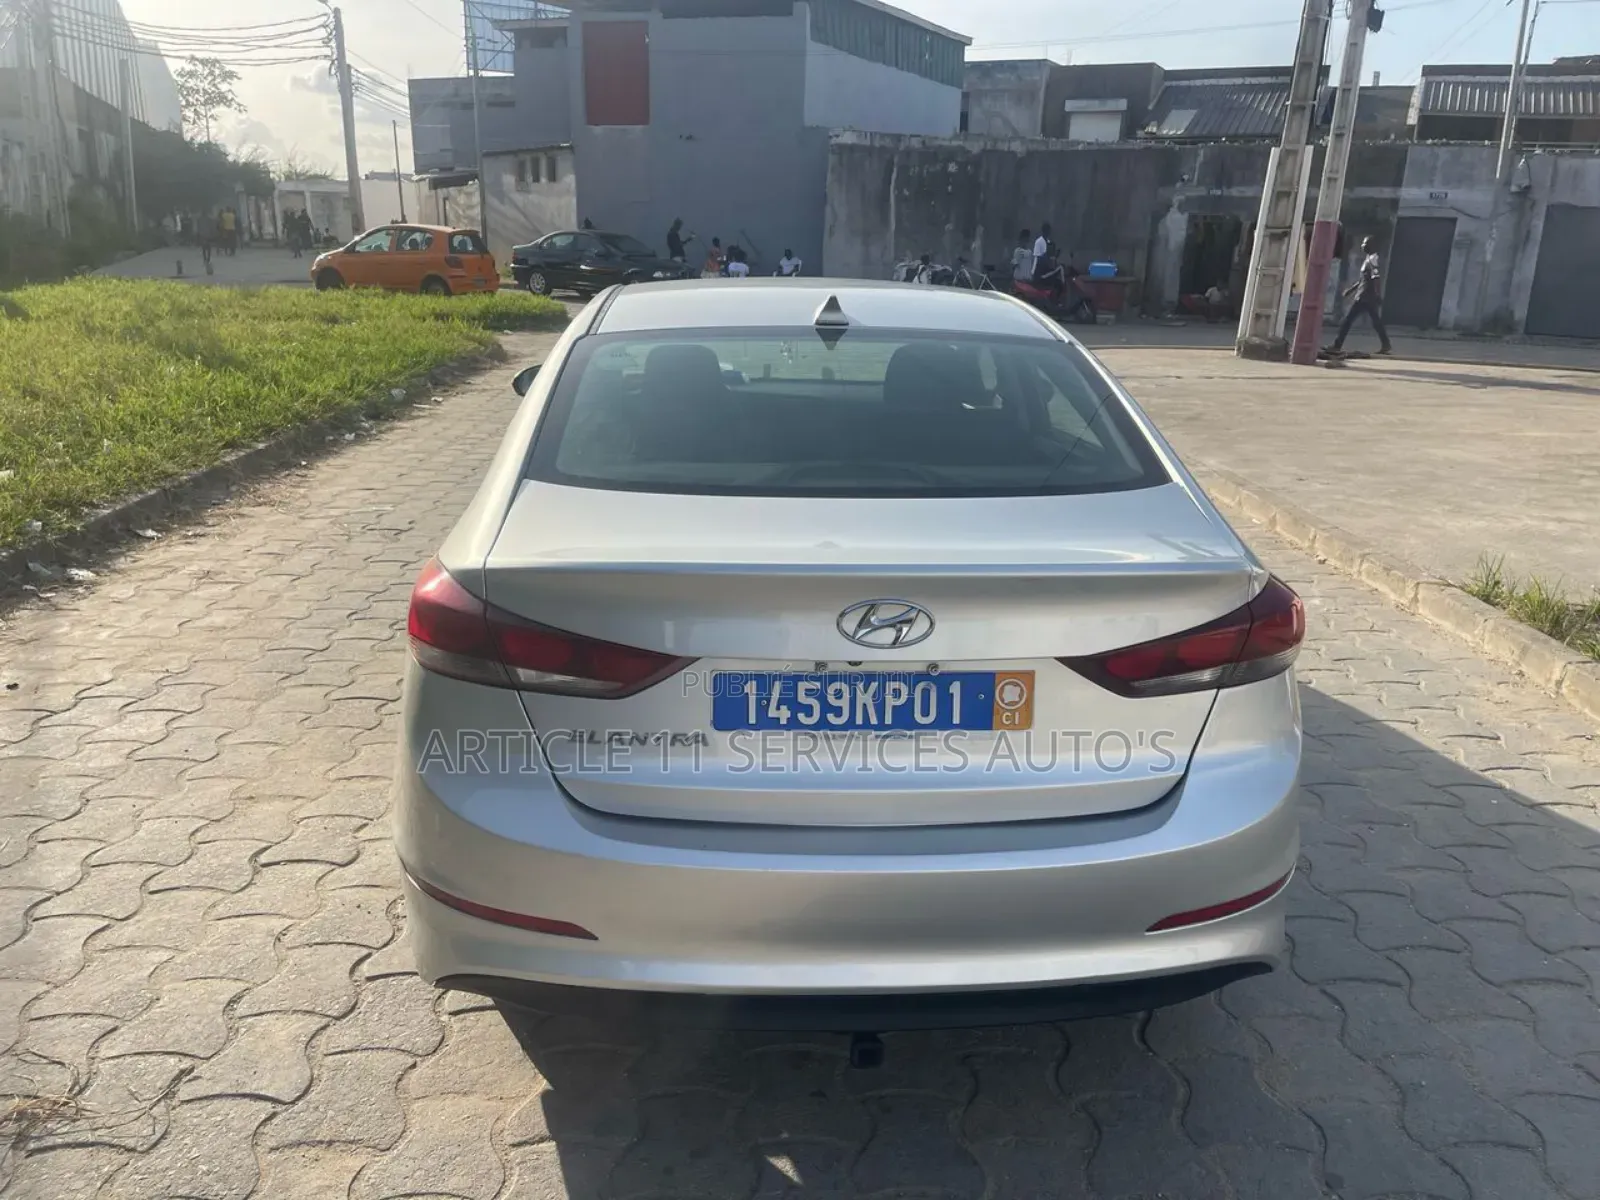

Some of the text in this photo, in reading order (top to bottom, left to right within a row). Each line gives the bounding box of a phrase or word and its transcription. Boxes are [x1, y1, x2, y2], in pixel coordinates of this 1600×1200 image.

[744, 681, 960, 724] 1459KP01
[1001, 711, 1020, 725] CI
[568, 729, 710, 747] ELANTRA
